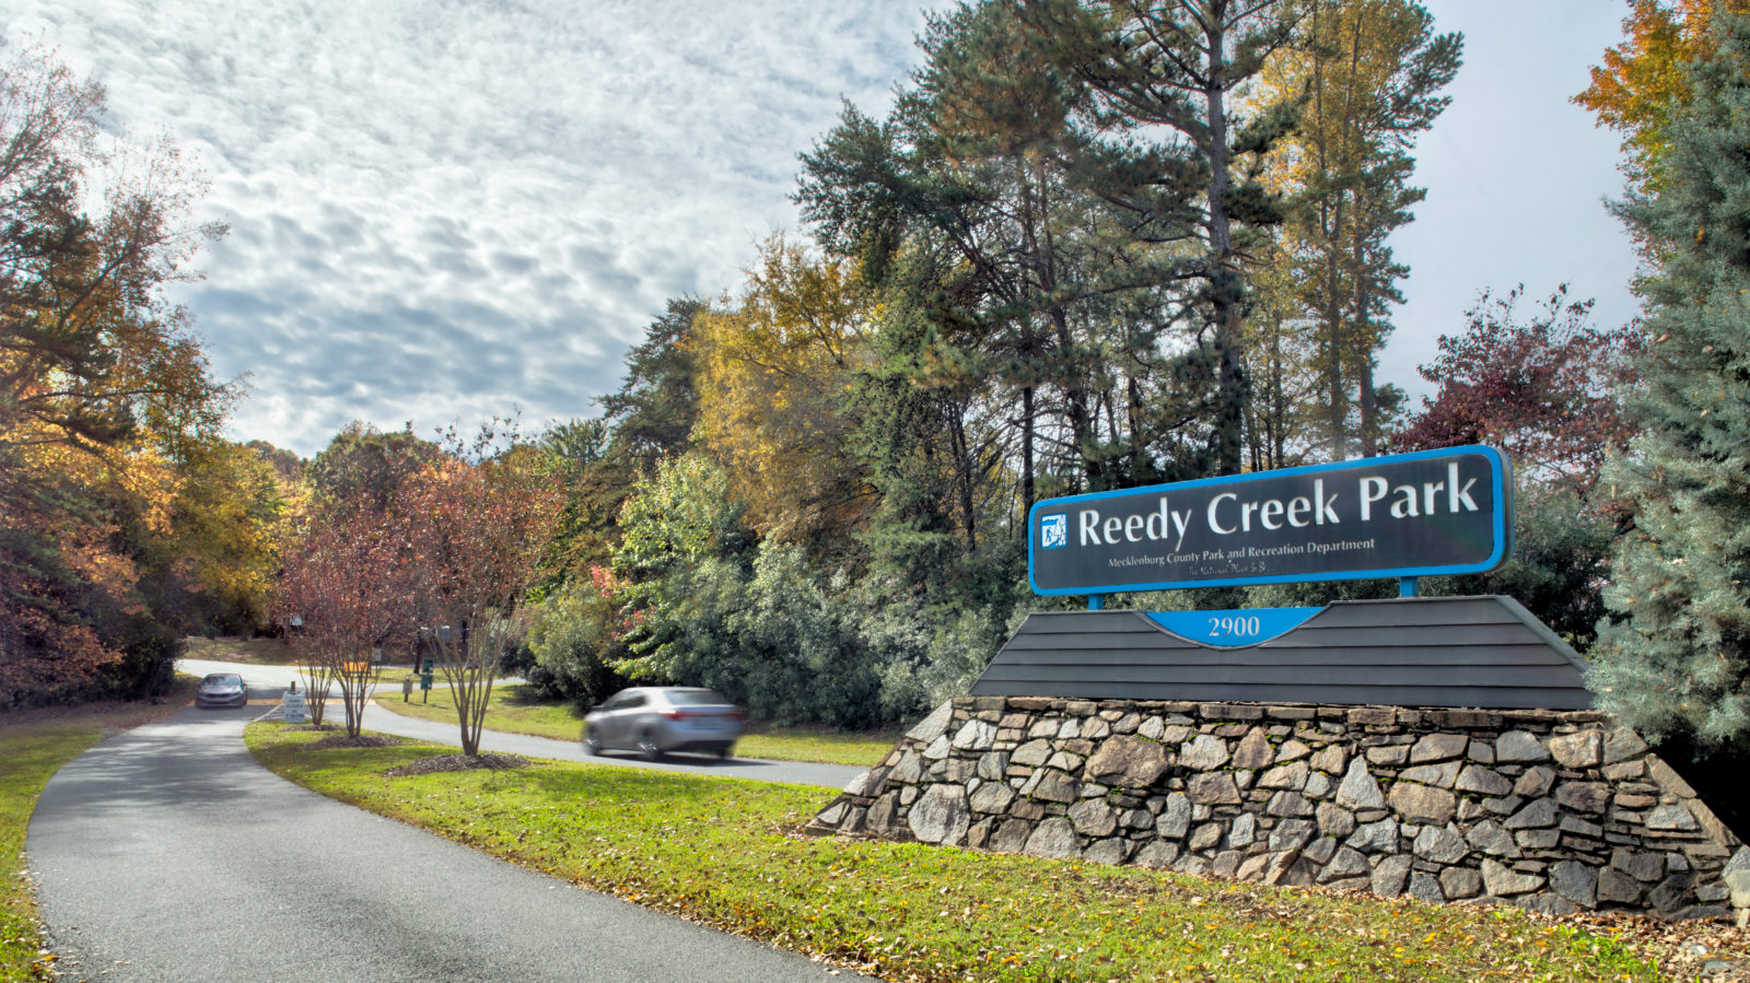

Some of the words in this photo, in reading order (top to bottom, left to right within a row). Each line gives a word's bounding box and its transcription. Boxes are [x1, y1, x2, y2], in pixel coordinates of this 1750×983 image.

[1079, 496, 1192, 552] Reedy
[1207, 479, 1340, 535] Creek
[1359, 462, 1479, 521] Park
[1108, 554, 1165, 568] Mecklenburg
[1166, 551, 1200, 564] County
[1202, 548, 1224, 560] Park
[1227, 547, 1245, 558] and
[1248, 543, 1303, 557] Recreation
[1307, 538, 1375, 554] Department
[1208, 616, 1260, 636] 2900
